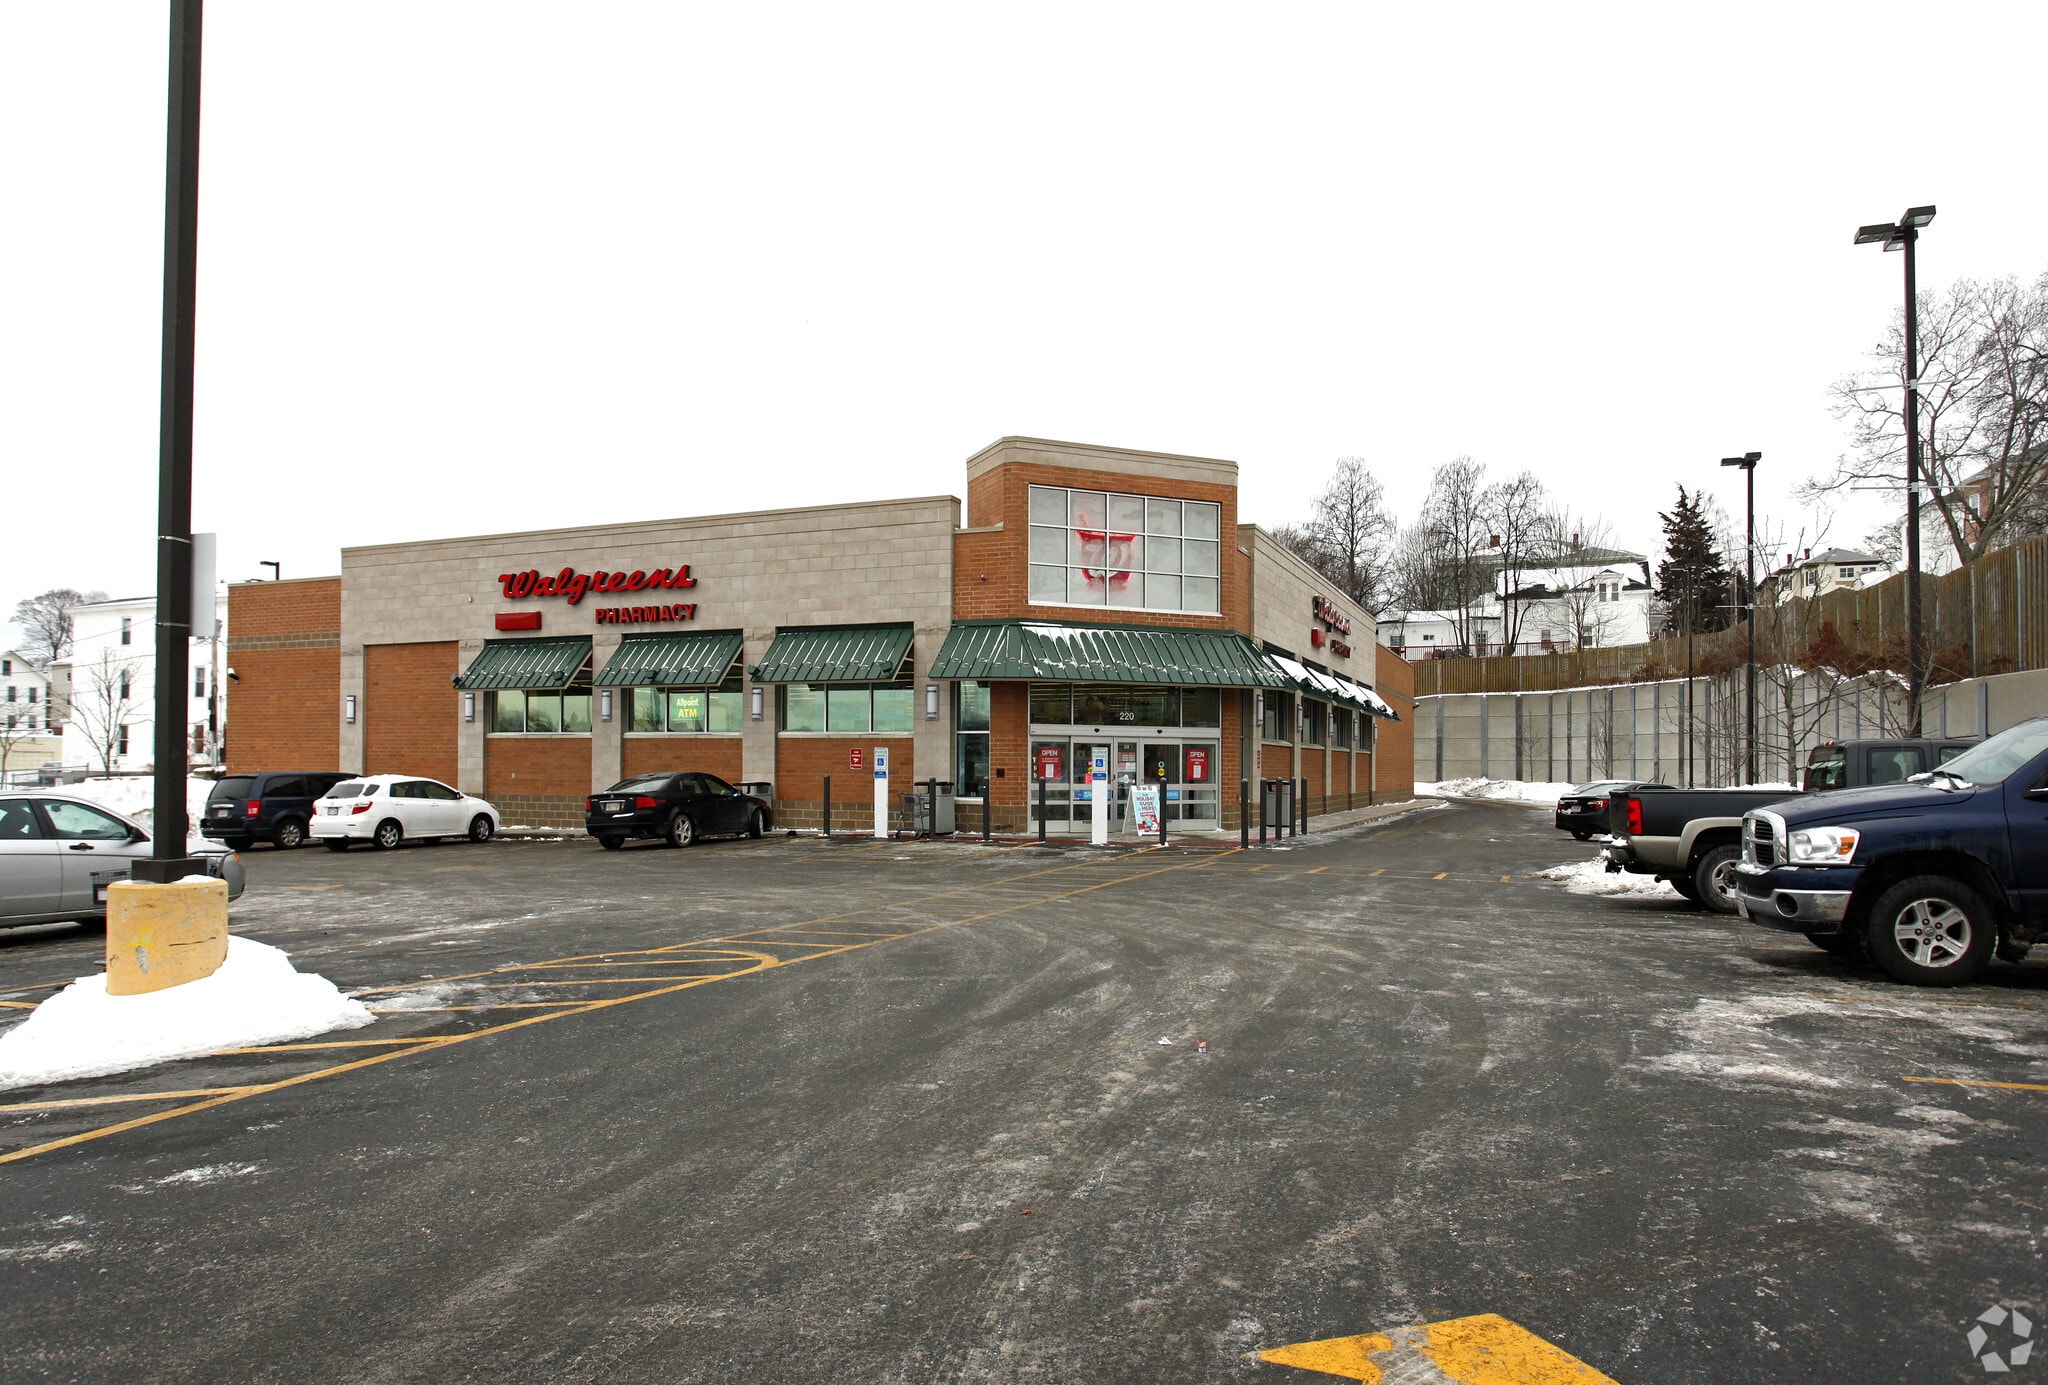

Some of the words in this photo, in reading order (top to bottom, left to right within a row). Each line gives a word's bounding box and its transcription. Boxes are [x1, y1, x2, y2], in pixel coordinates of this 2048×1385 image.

[498, 564, 698, 605] Walgreens
[595, 603, 698, 625] PHARMACY
[676, 695, 699, 708] Allpoint
[678, 708, 698, 718] ATM
[1119, 711, 1135, 721] 220
